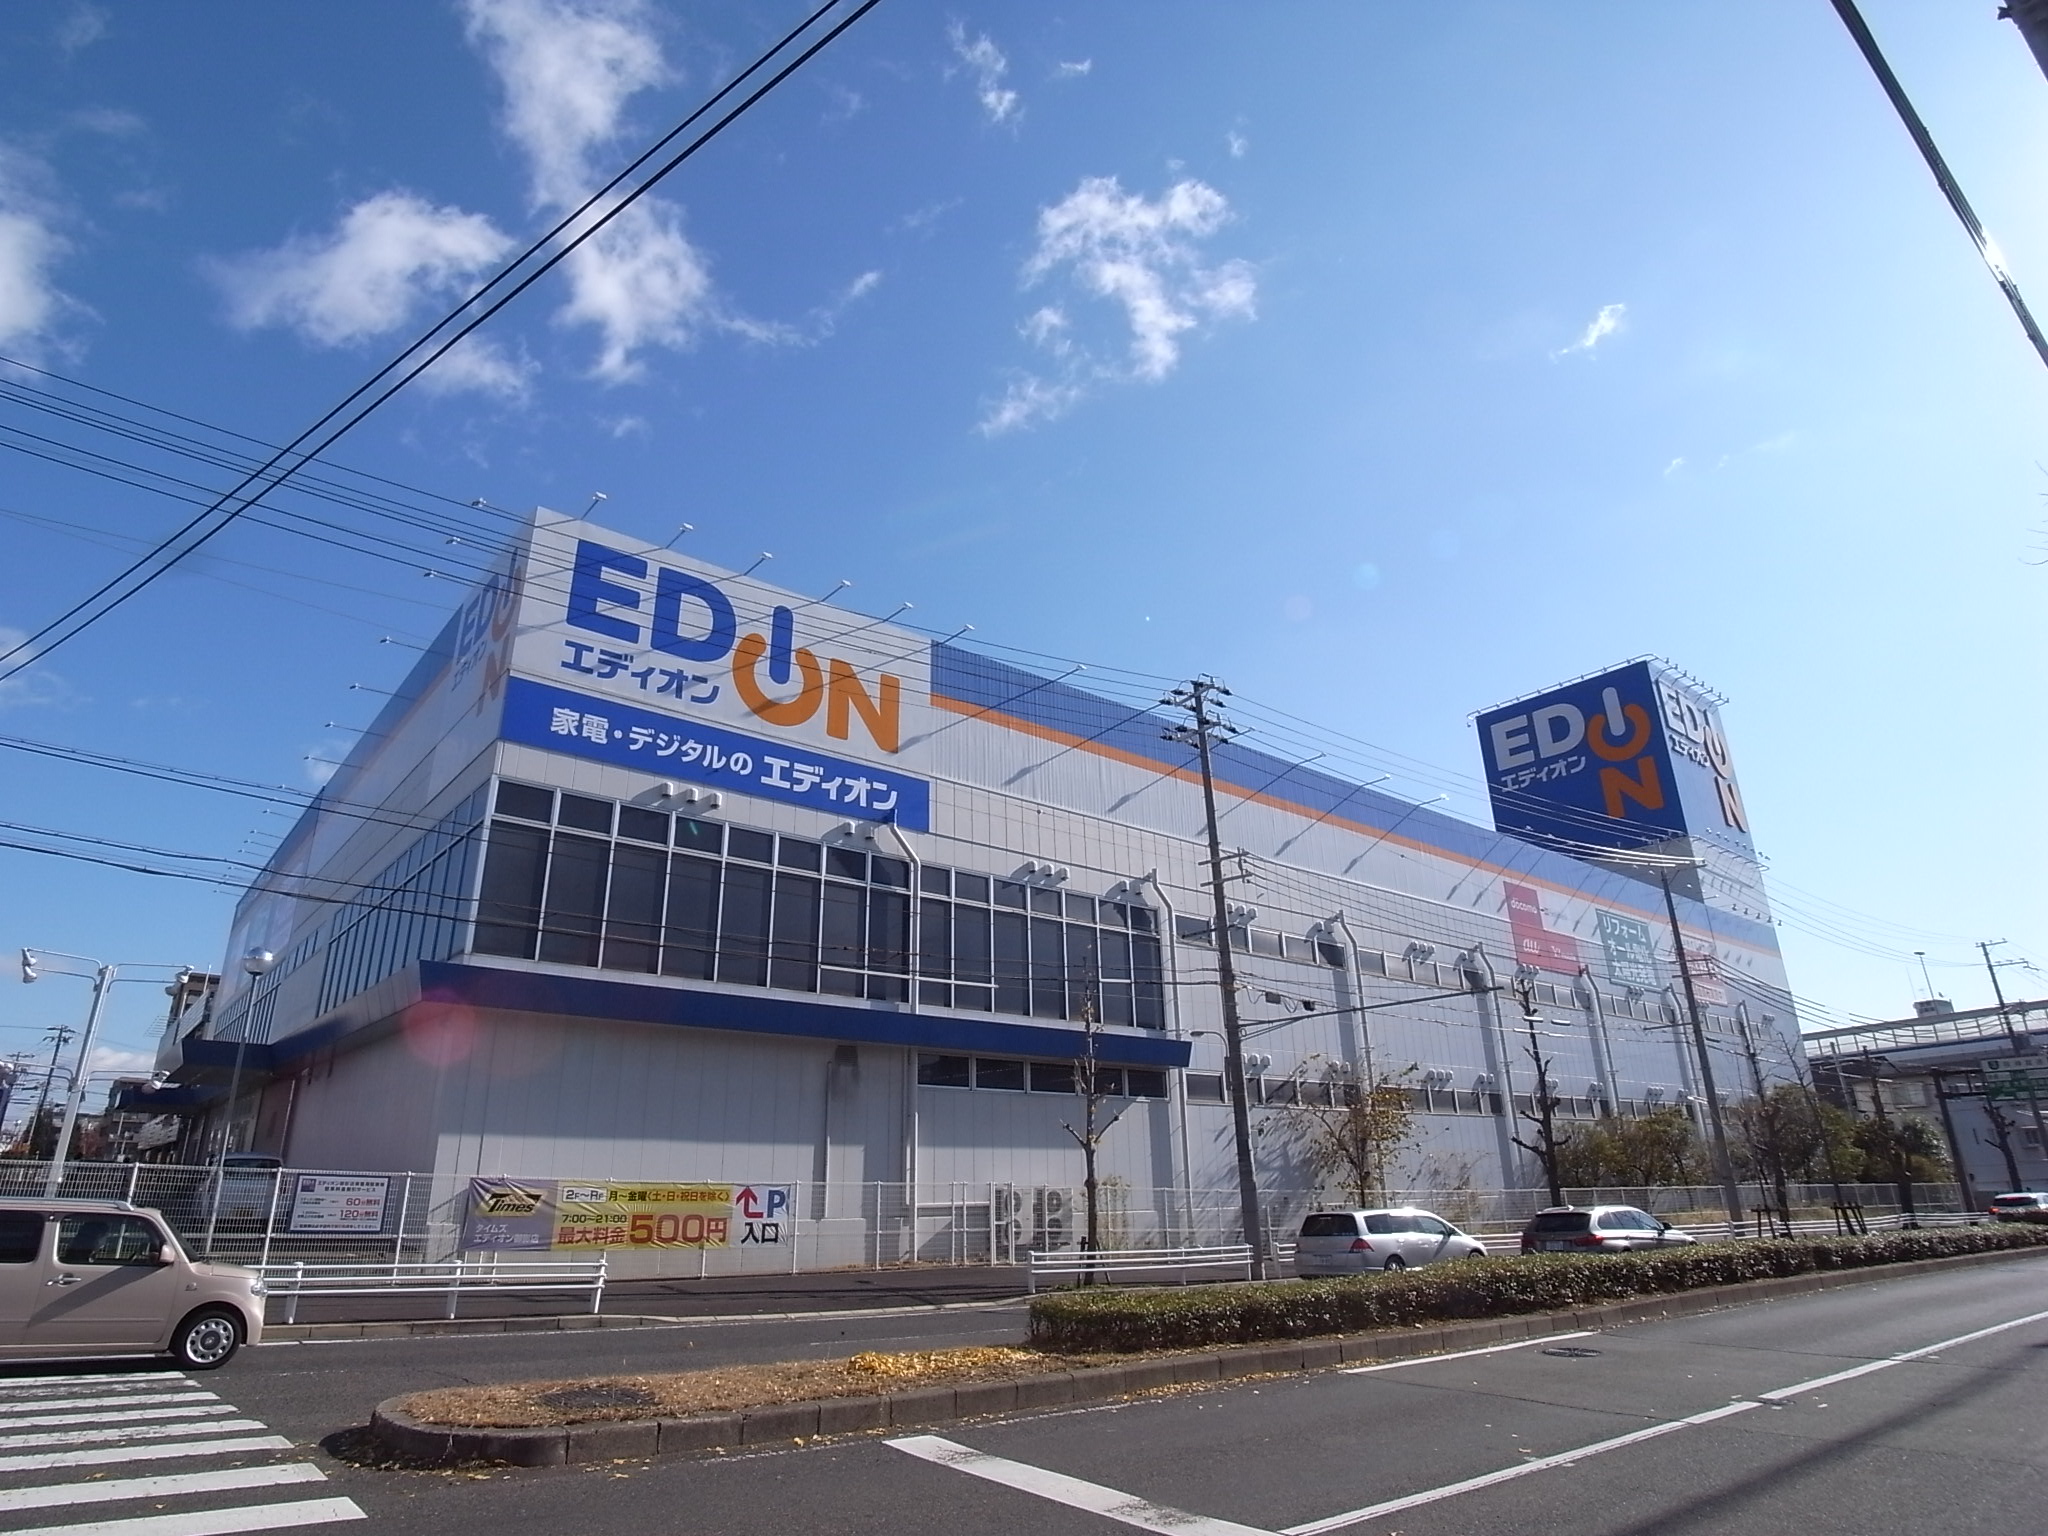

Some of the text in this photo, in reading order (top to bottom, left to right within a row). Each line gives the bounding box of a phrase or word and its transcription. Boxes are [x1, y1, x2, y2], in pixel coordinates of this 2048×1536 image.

[565, 539, 902, 754] EDION
[560, 639, 721, 705] エディオン
[549, 706, 899, 811] 家電・デジタルの エディオン
[1490, 686, 1665, 820] EDION
[1656, 678, 1748, 834] EDION
[1500, 754, 1587, 794] エディオン
[1510, 897, 1538, 914] docomo
[1603, 915, 1647, 943] リフォーム
[487, 1192, 544, 1213] Times
[766, 1189, 786, 1218] P
[475, 1223, 508, 1233] タイムズ
[740, 1221, 779, 1244] 入口
